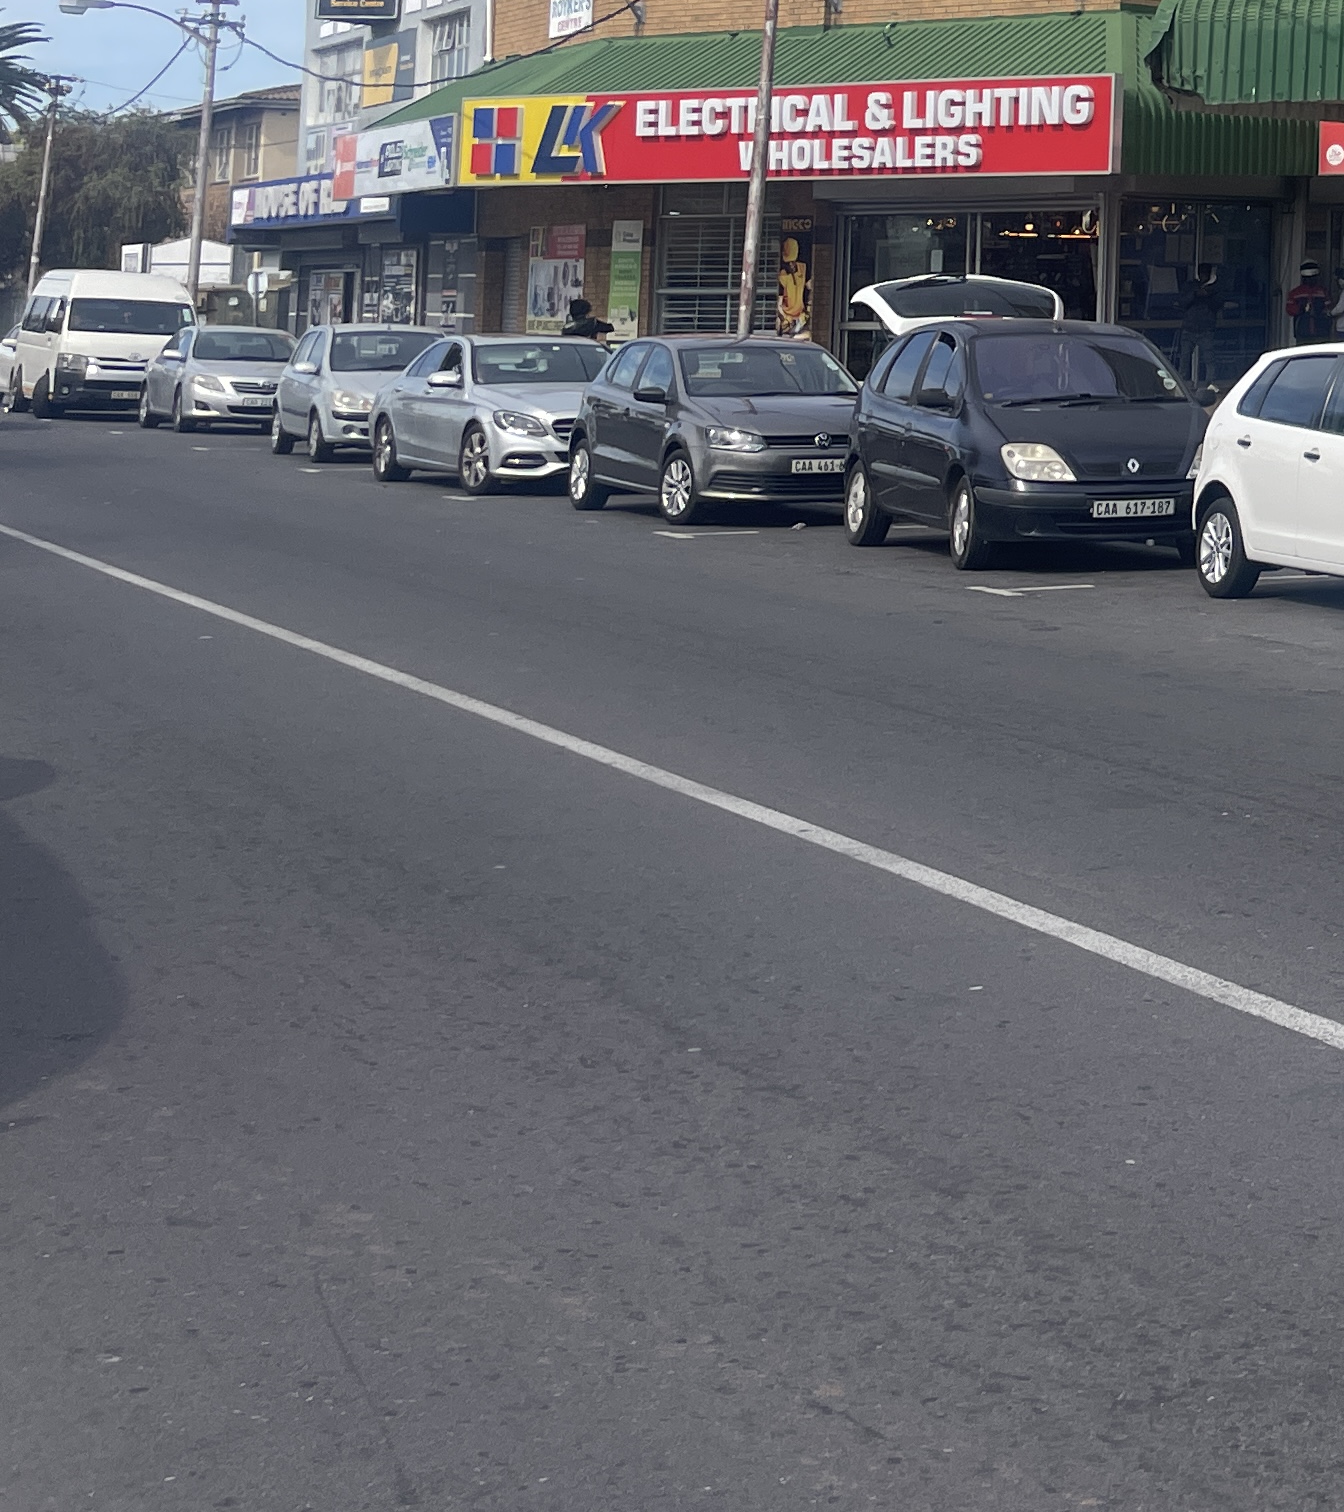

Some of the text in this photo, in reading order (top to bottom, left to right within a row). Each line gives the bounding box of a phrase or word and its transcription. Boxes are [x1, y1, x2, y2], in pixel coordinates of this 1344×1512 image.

[865, 92, 895, 130] &
[903, 85, 1094, 129] LIGHTING
[254, 184, 298, 219] HOUSE
[299, 180, 319, 216] OF
[795, 461, 813, 472] CAA
[1096, 501, 1171, 516] CAA 617-187
